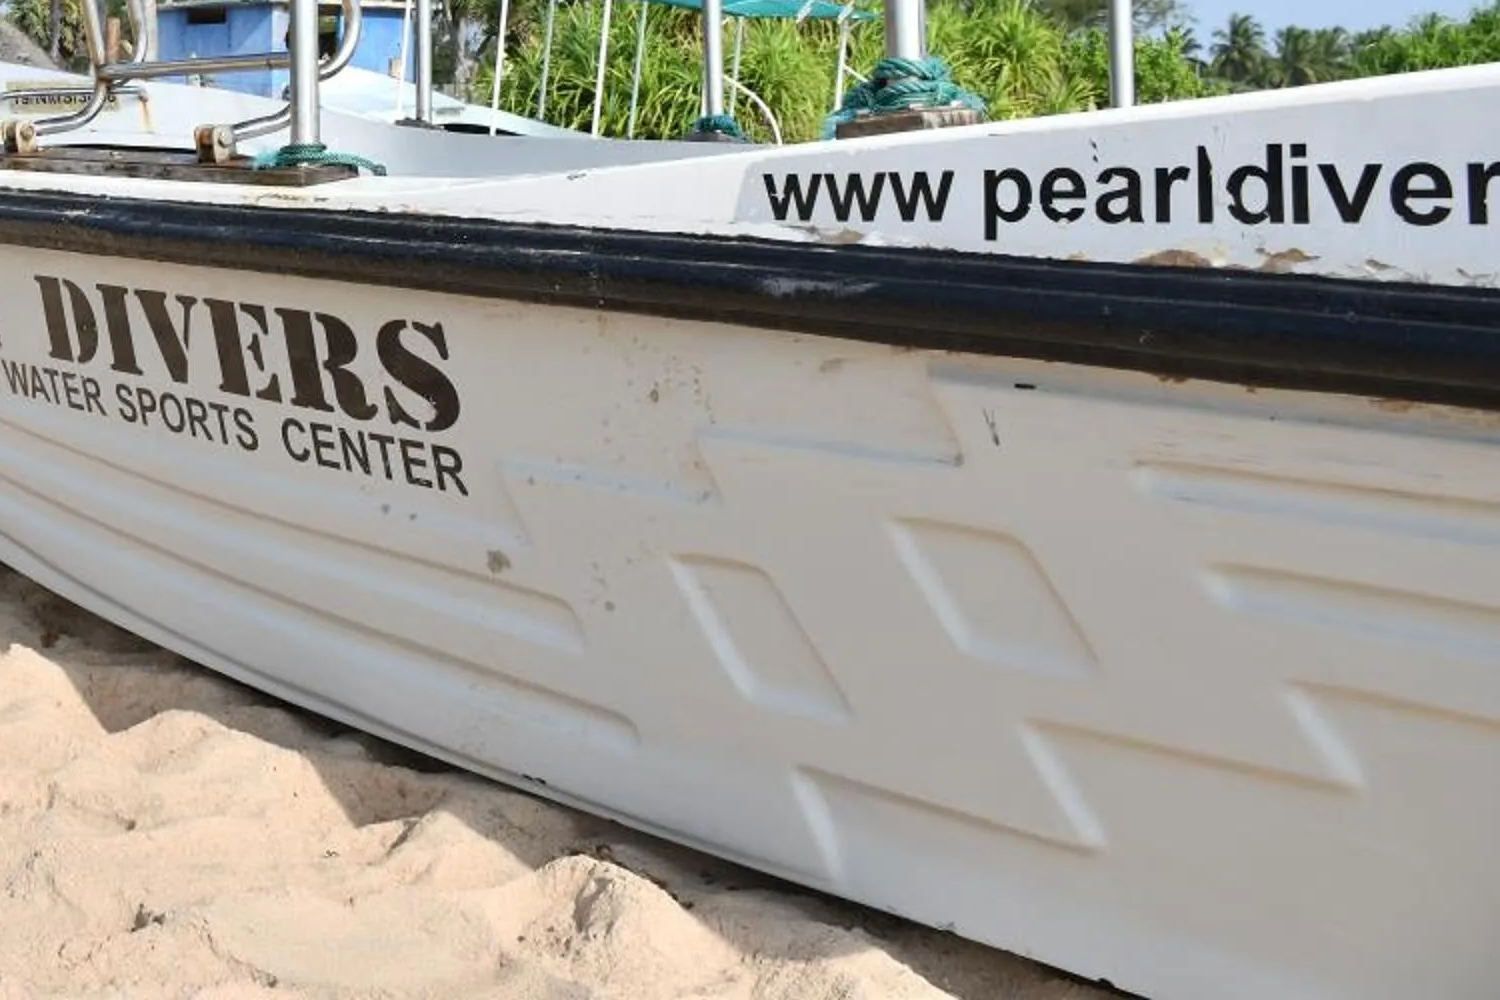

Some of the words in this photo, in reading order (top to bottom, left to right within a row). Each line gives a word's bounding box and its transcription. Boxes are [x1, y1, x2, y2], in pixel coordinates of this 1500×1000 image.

[763, 169, 954, 222] www
[984, 143, 1500, 241] pearldiver
[33, 274, 461, 432] DIVERS
[1, 357, 107, 417] WATER
[115, 383, 258, 451] SPORTS
[281, 417, 468, 496] CENTER
